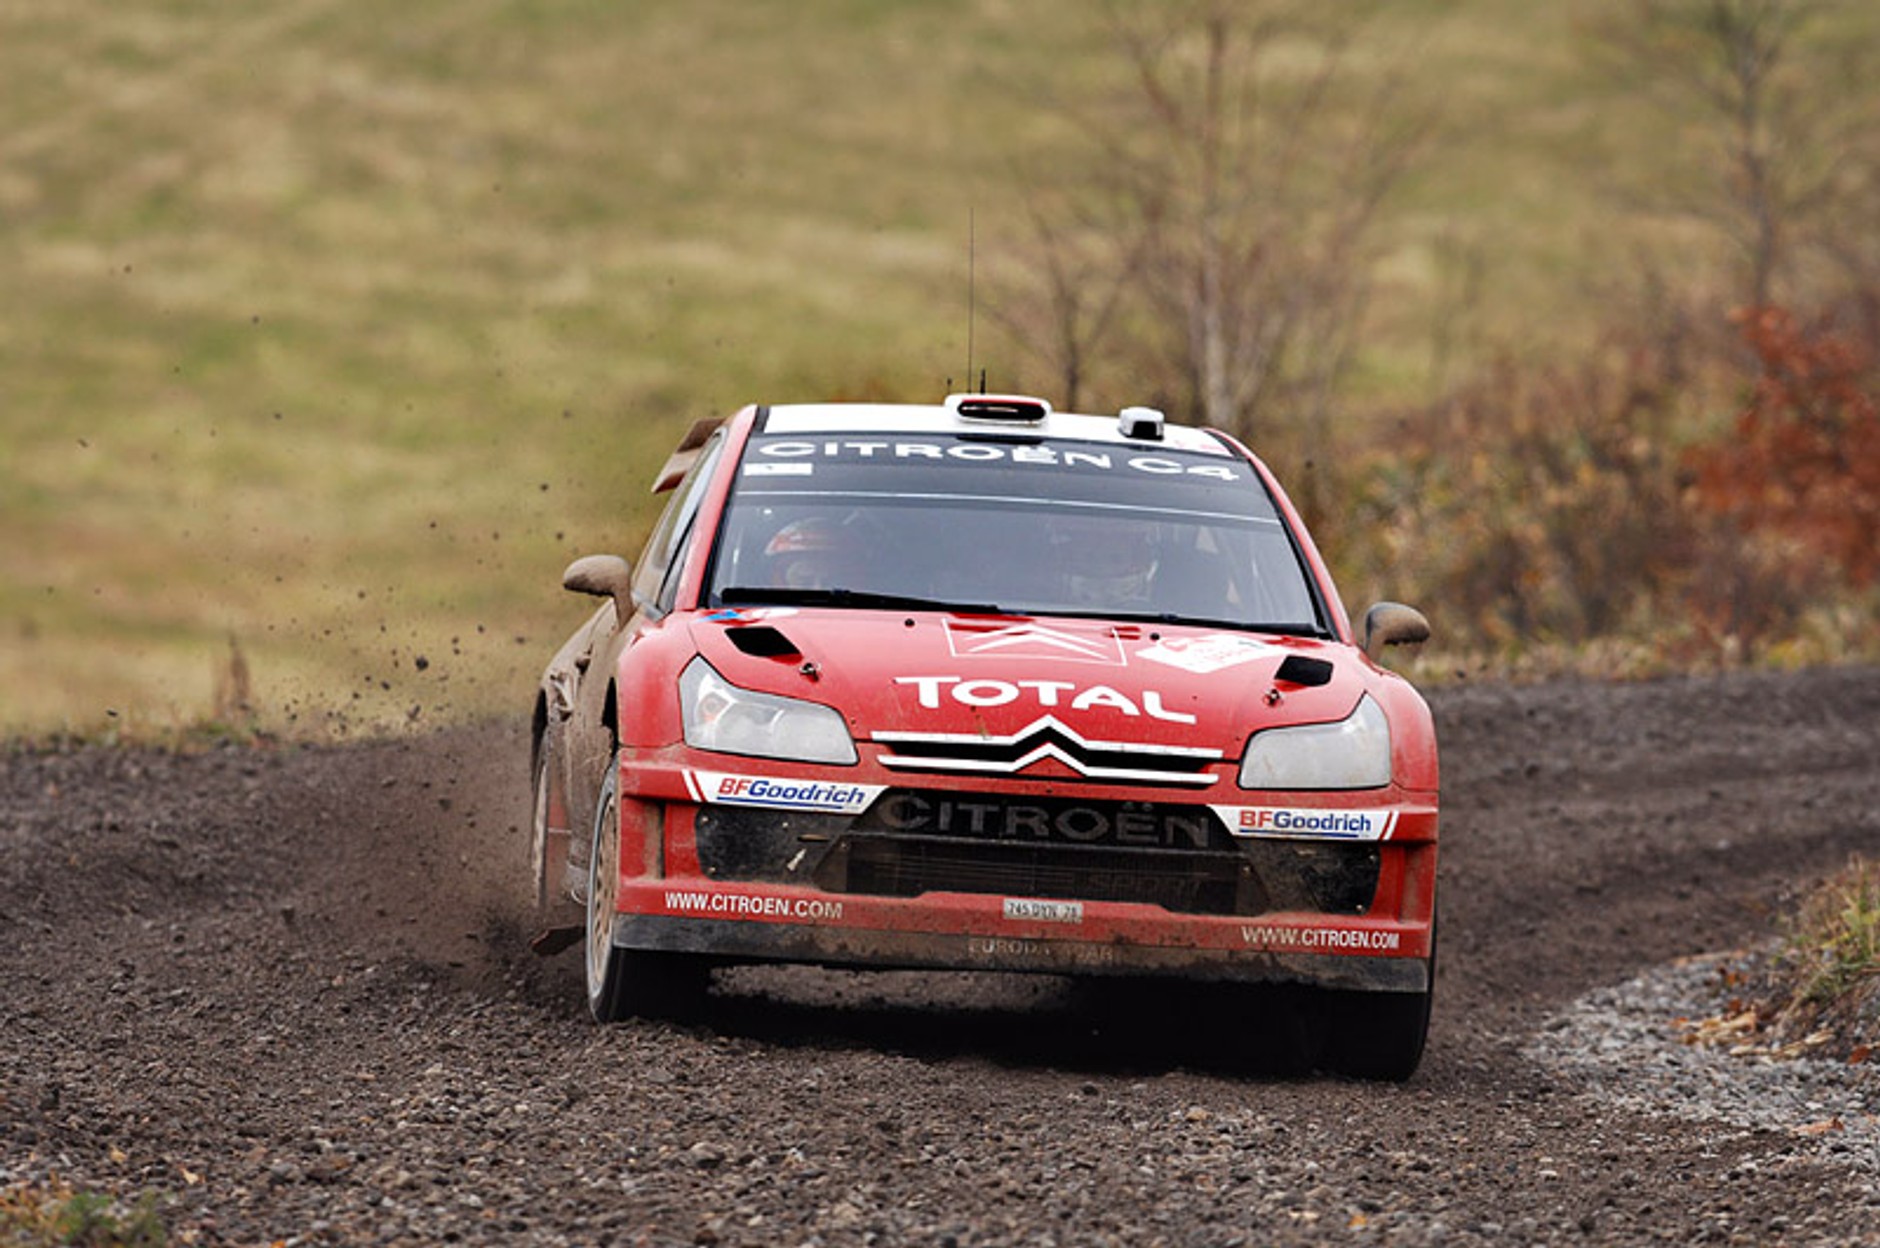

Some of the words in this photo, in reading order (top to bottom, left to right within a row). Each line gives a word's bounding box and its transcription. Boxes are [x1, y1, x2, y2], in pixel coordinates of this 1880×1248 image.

[759, 442, 1112, 469] CITROËN
[1128, 456, 1239, 481] C4
[894, 676, 1197, 724] TOTAL
[718, 777, 866, 805] BFGoodrich
[878, 795, 1210, 847] CITROËN
[1238, 810, 1371, 833] BFGoodrich
[665, 891, 843, 919] WWW.CITROEN.COM
[1241, 926, 1399, 950] WWW.CITROEN.COM
